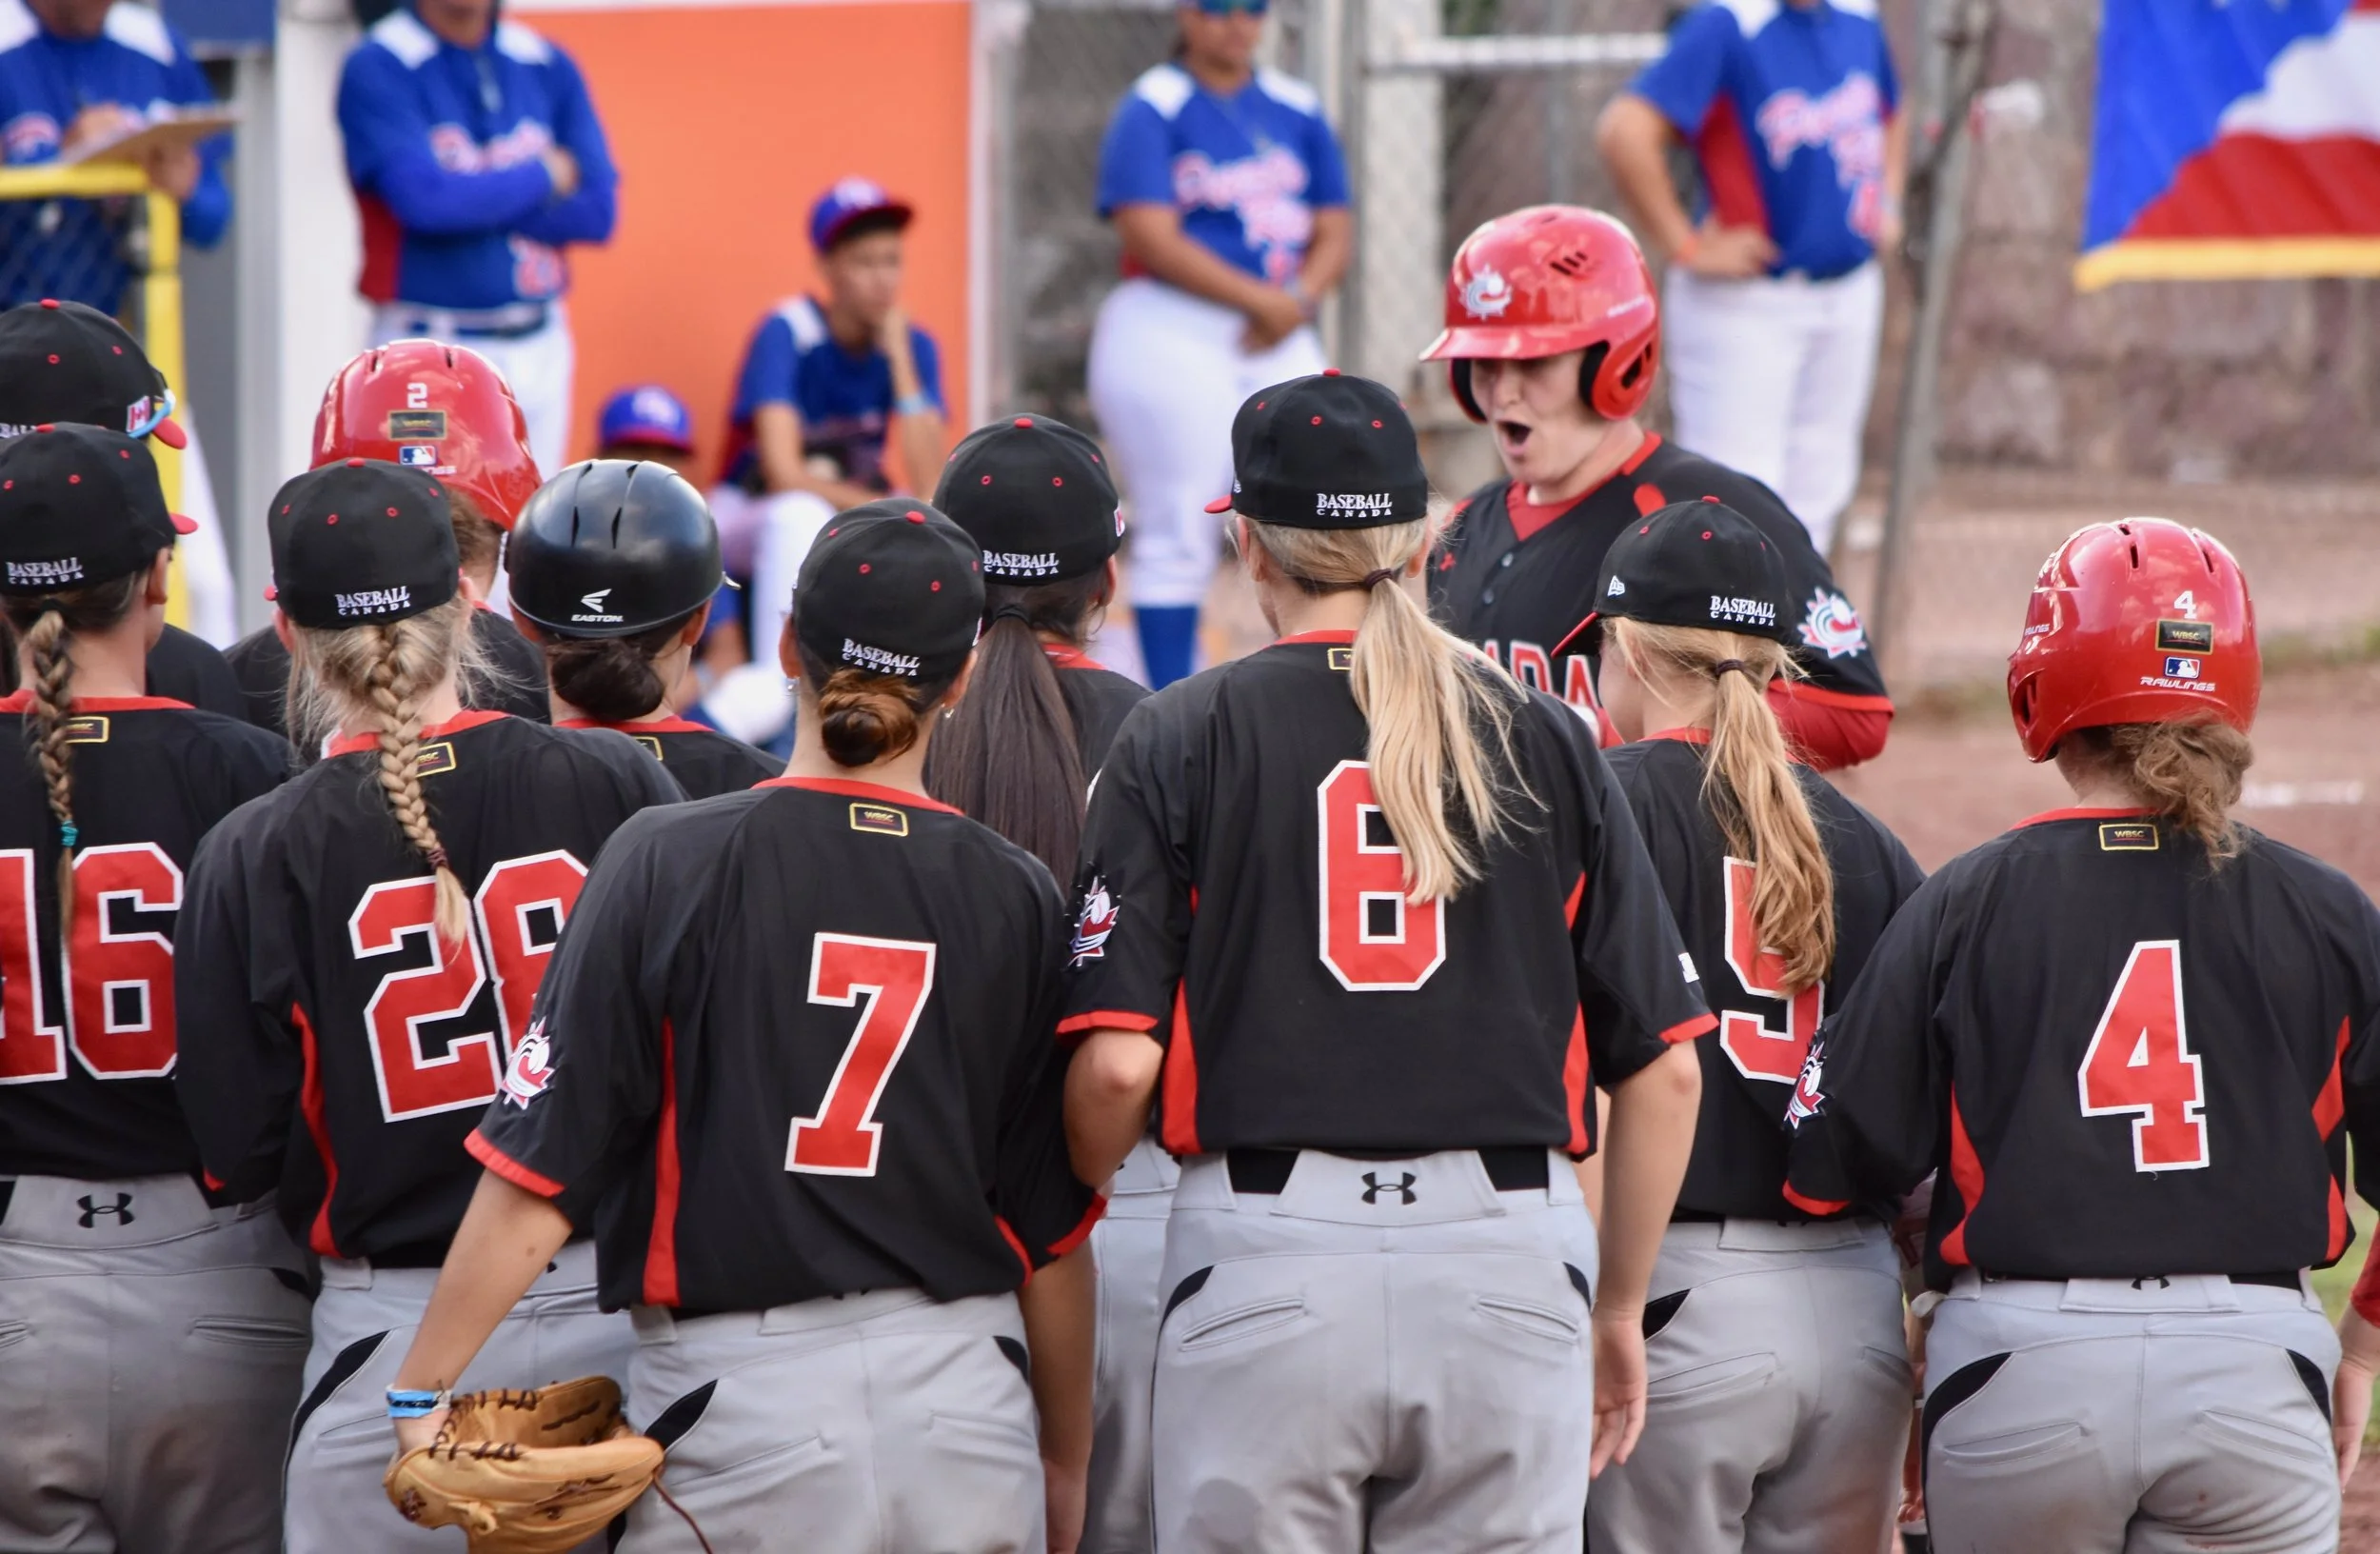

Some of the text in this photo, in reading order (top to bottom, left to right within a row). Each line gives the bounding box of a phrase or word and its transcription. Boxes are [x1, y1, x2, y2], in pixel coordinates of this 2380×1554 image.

[407, 383, 428, 408] 2
[1316, 492, 1393, 509] BASEBALL
[1316, 508, 1392, 518] CANADA
[6, 556, 83, 578] BASEBALL
[982, 549, 1060, 568] BASEBALL
[8, 571, 85, 585] CANADA
[983, 565, 1060, 577] CANADA
[335, 586, 411, 608] BASEBALL
[338, 600, 411, 616] CANADA
[1709, 595, 1776, 619] BASEBALL
[2173, 589, 2197, 619] 4
[571, 614, 625, 623] EASTON
[1710, 611, 1775, 627] CANADA
[2172, 630, 2200, 641] WBSC
[841, 652, 918, 676] CANADA
[842, 638, 921, 668] BASEBALL
[2140, 676, 2216, 691] RAWLINGS
[2113, 829, 2146, 838] WBSC
[1318, 760, 1446, 991] 6
[0, 842, 184, 1085] 16
[1719, 855, 1825, 1085] 5
[784, 932, 937, 1177] 7
[2078, 940, 2210, 1172] 4
